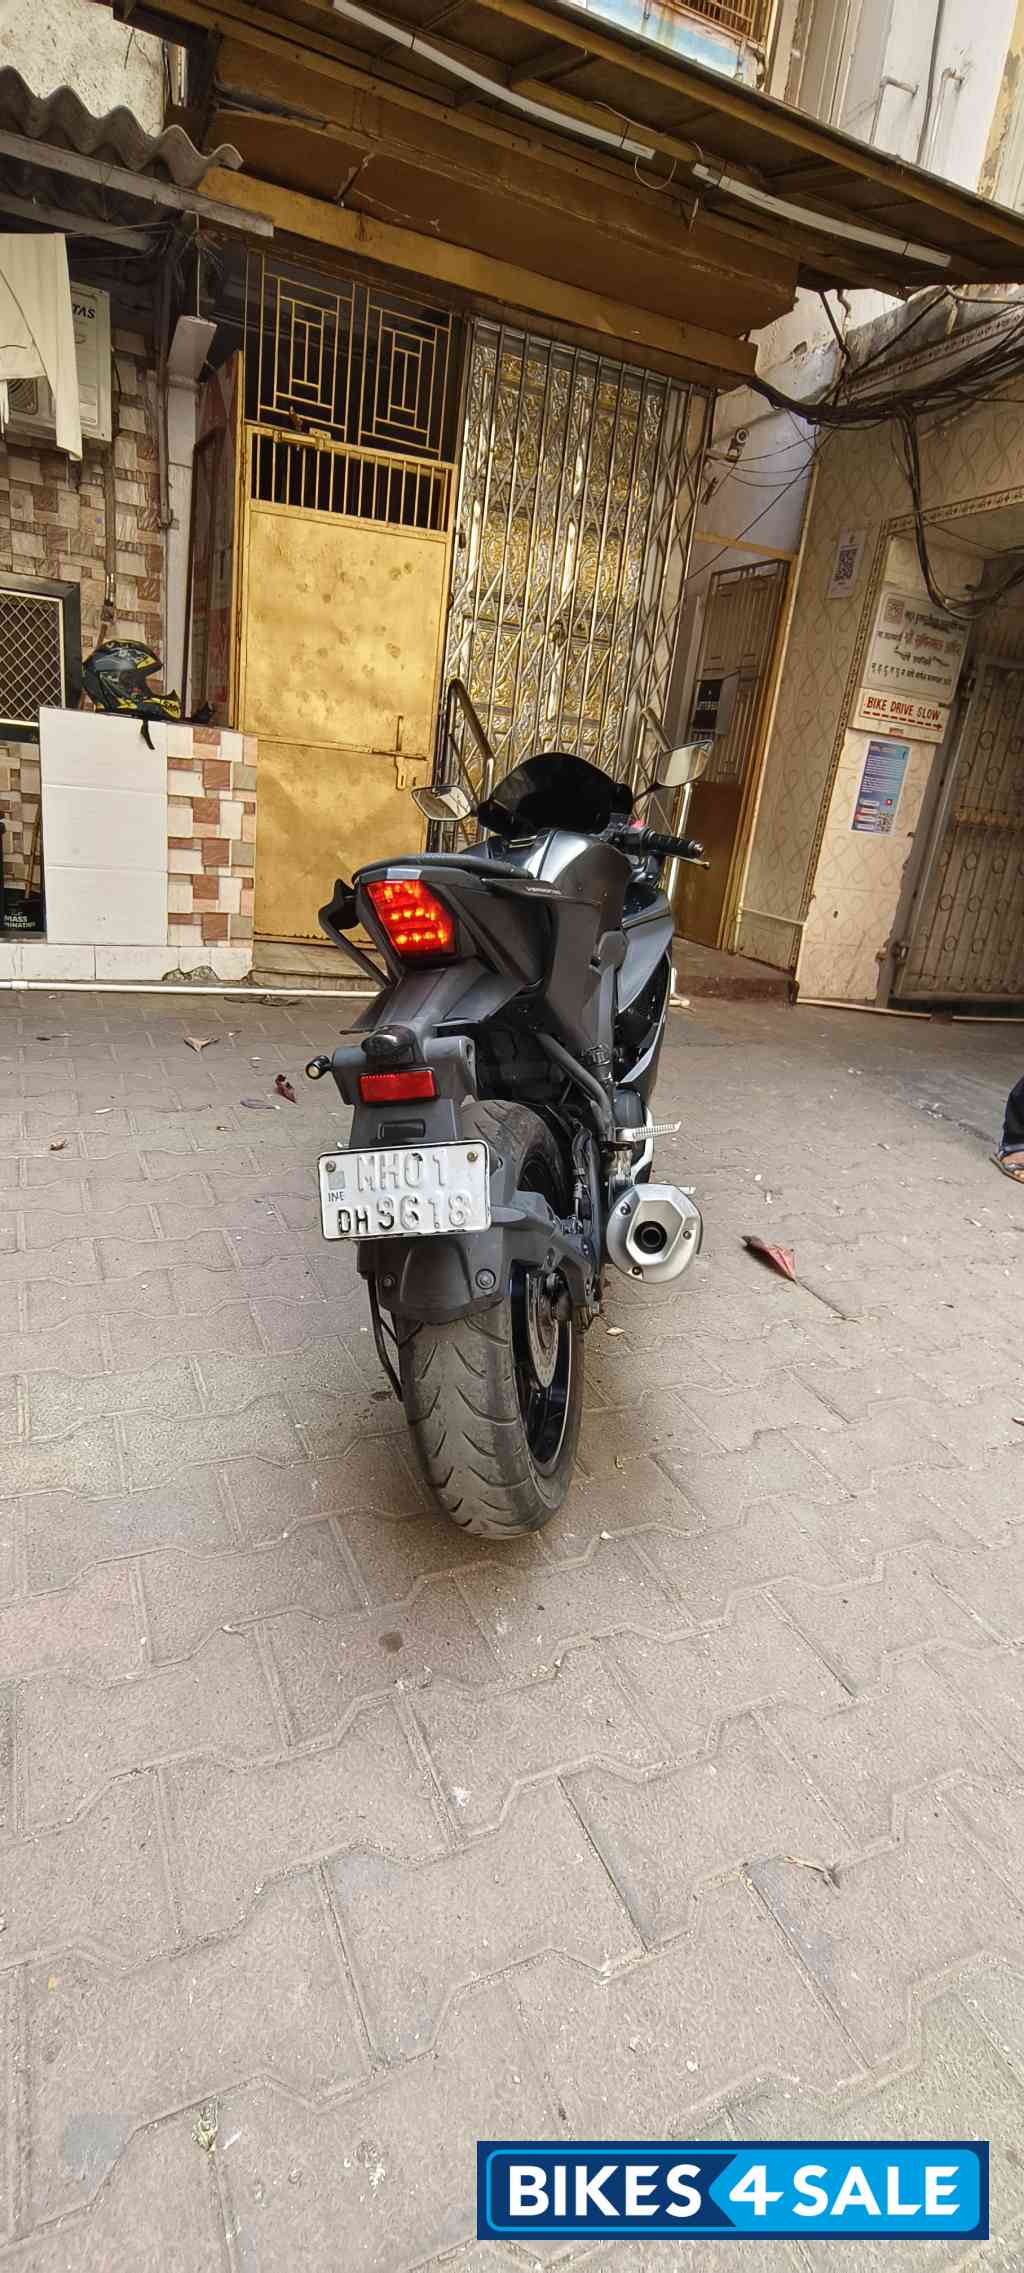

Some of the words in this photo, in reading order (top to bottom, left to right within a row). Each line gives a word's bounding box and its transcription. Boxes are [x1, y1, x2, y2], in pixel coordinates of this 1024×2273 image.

[866, 696, 888, 711] BIKE
[890, 701, 914, 716] DRIVE
[917, 706, 941, 720] SLOW
[357, 1150, 448, 1192] MH01
